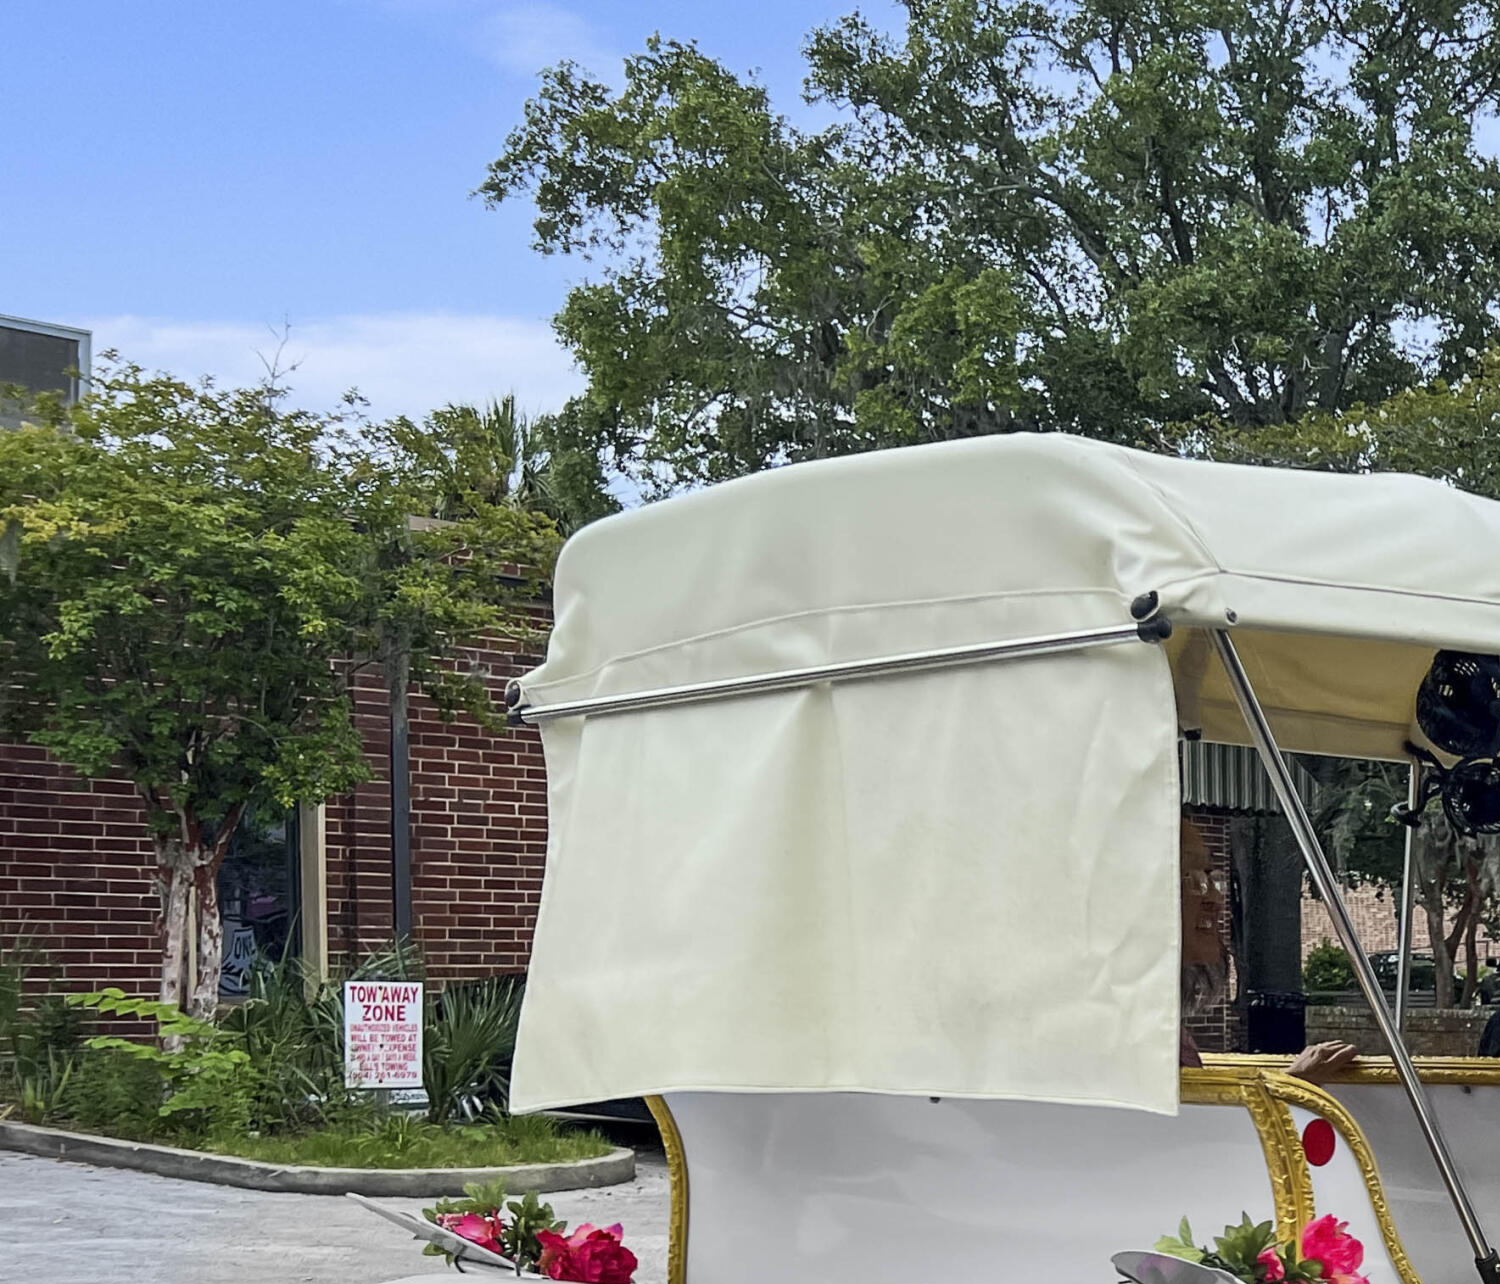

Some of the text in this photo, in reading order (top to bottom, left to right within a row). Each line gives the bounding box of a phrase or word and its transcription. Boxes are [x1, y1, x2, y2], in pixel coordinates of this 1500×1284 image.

[349, 986, 419, 1004] TOW AWAY
[362, 1005, 406, 1021] ZONE
[380, 1034, 406, 1042] TOWED
[408, 1034, 417, 1042] AT
